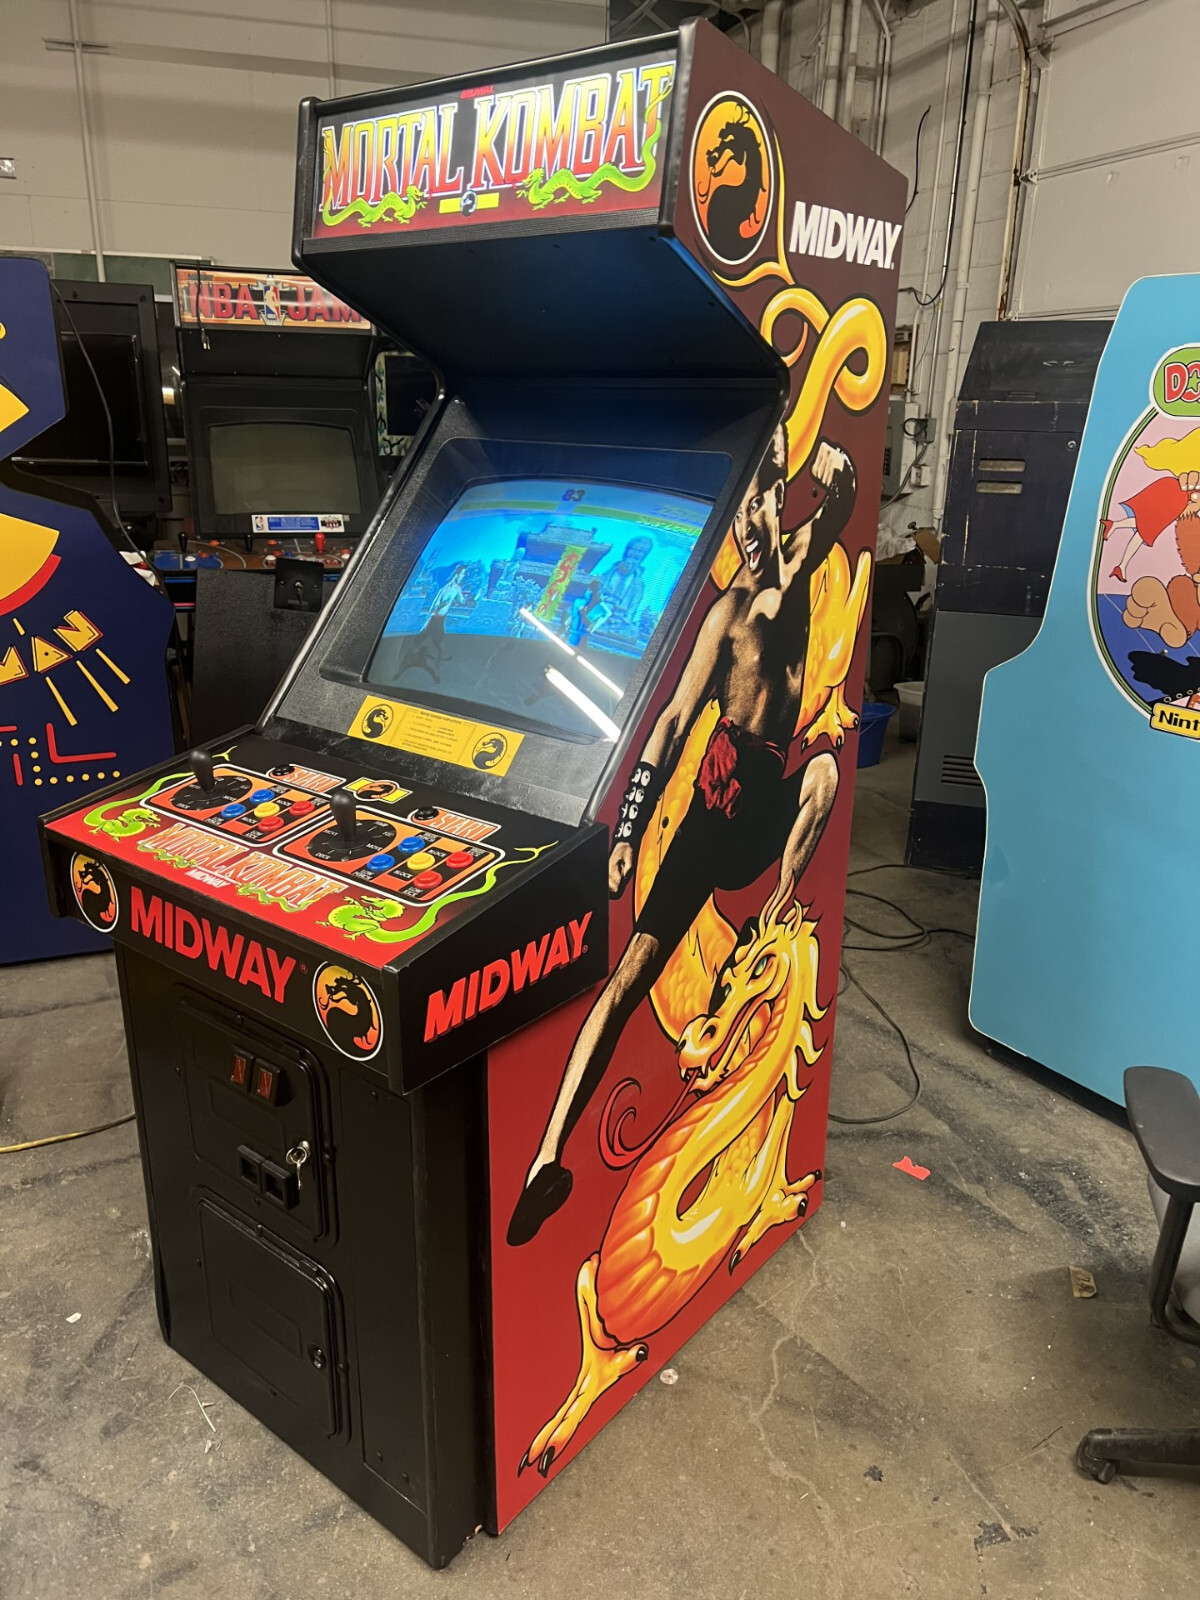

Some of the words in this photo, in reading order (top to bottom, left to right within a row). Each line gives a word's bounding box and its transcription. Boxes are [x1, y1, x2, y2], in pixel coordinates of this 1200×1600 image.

[319, 102, 464, 212] MORTAL
[467, 60, 677, 191] KOMBAT
[789, 200, 903, 270] MIDWAY
[188, 281, 260, 320] NBA
[283, 769, 341, 793] START
[430, 813, 495, 839] START
[143, 823, 249, 876] MORTAL
[226, 852, 349, 910] KOMBAT
[185, 869, 231, 888] MIDWAY
[131, 886, 296, 1004] MIDWAY
[423, 911, 593, 1043] MIDWAY
